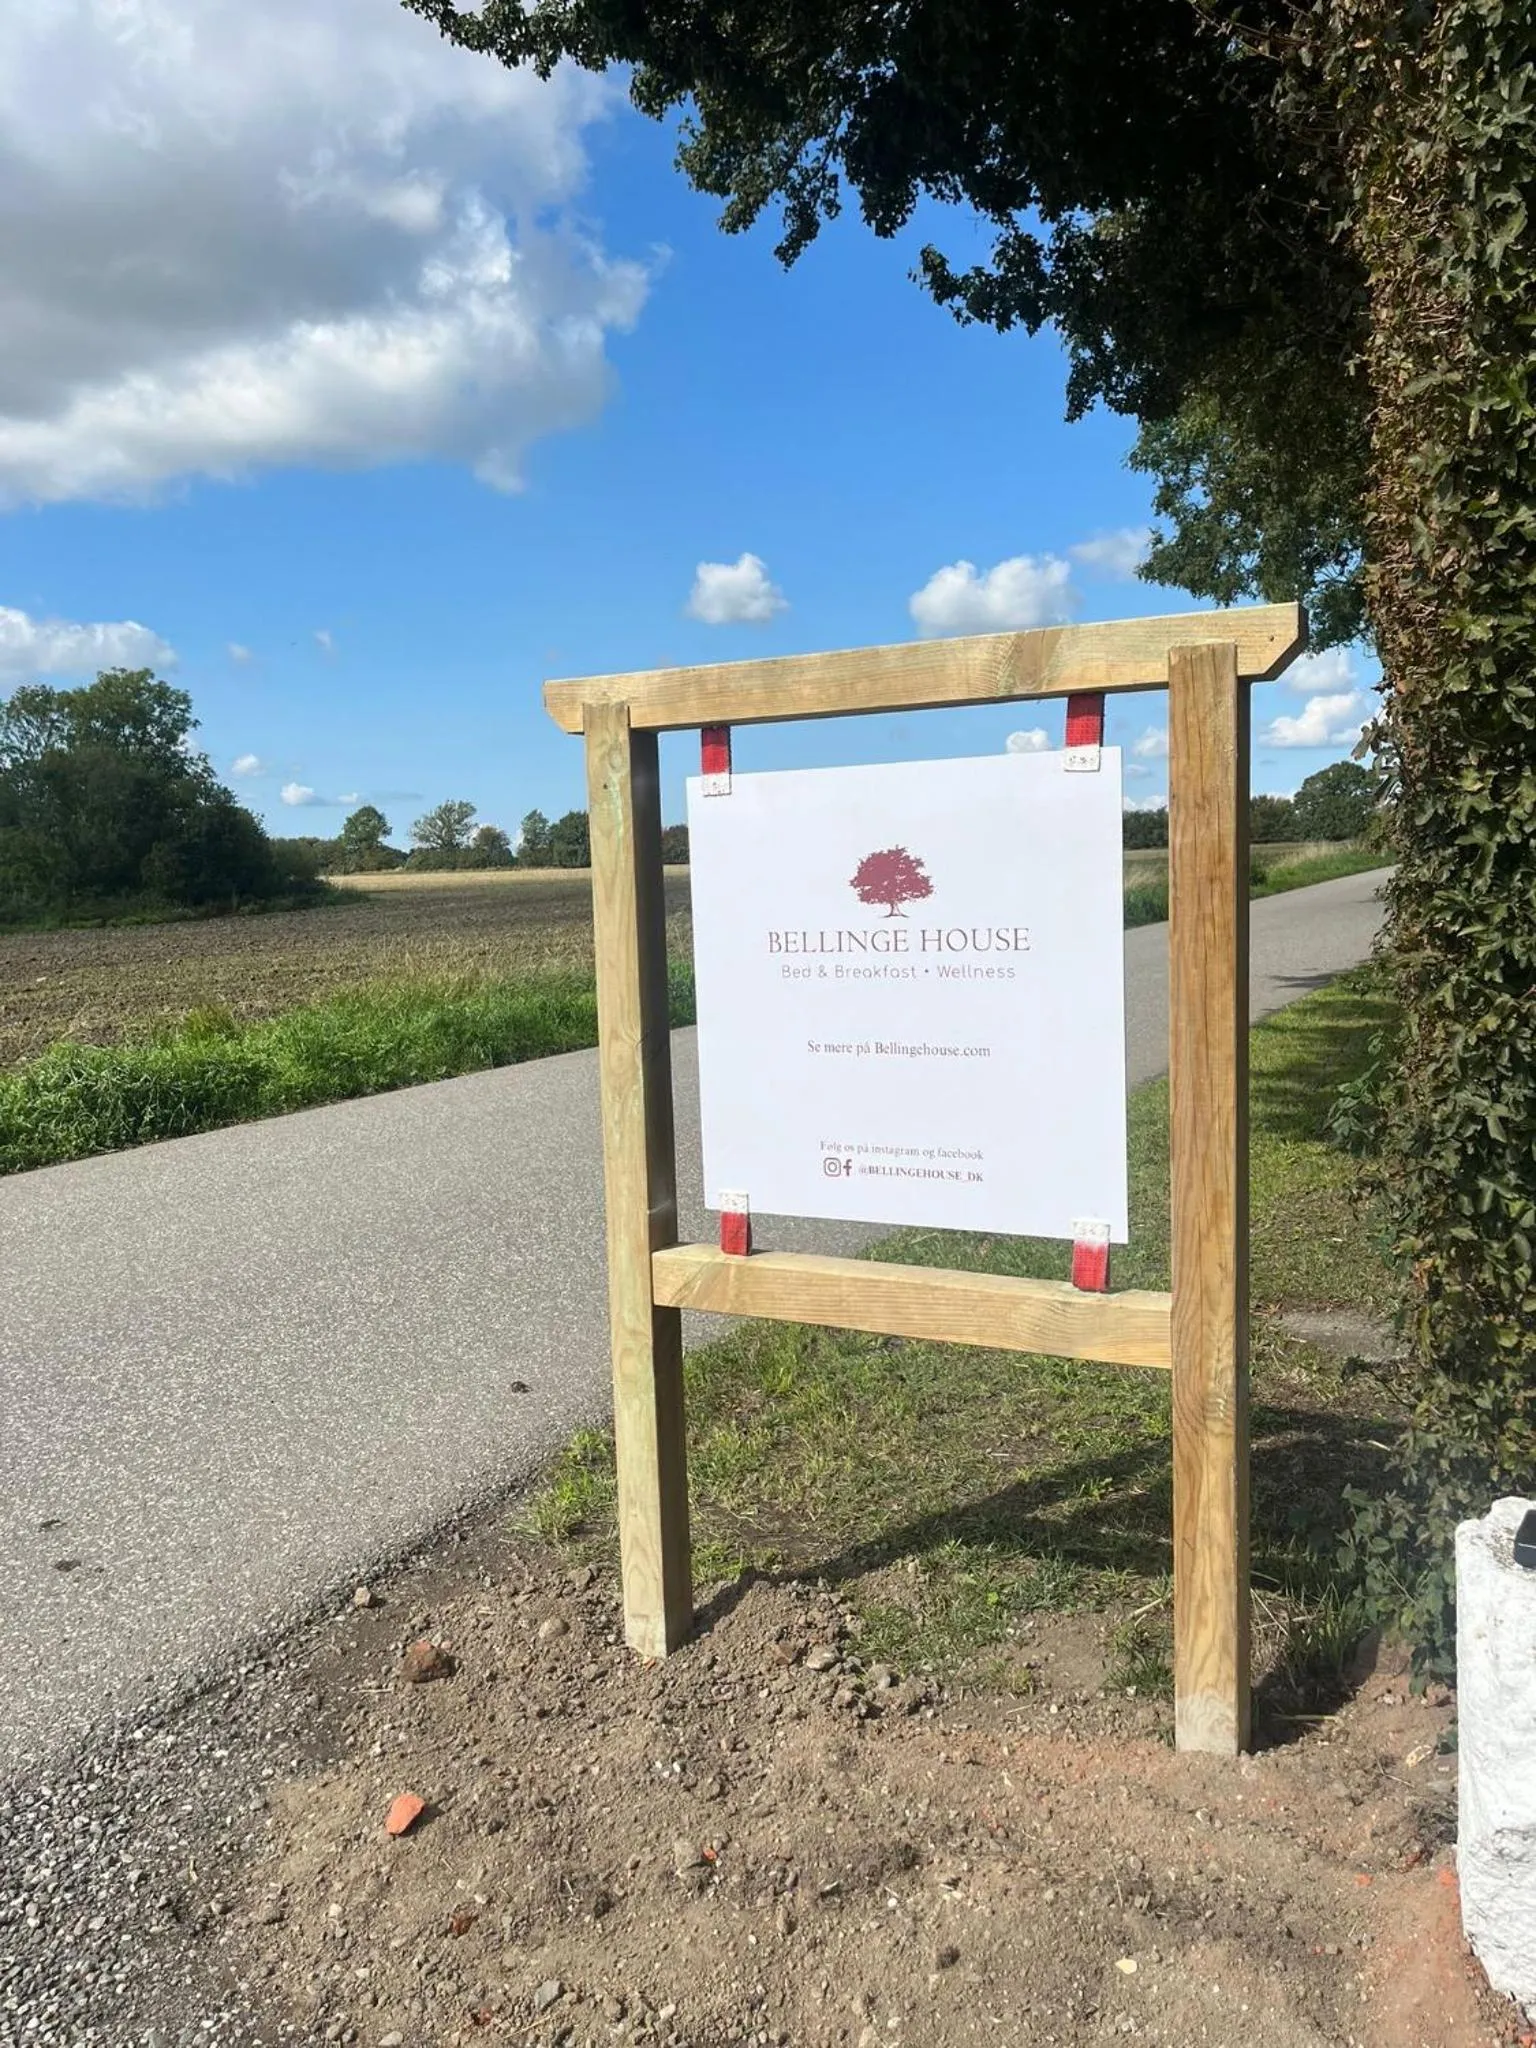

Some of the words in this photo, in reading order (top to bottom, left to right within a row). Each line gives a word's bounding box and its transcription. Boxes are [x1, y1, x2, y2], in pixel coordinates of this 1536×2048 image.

[769, 929, 909, 953] BELLINGE
[920, 927, 1031, 952] HOUSE
[781, 965, 811, 978] Bed
[818, 965, 828, 978] &
[835, 965, 917, 978] Breakfast
[937, 965, 1016, 978] Wellness
[807, 1040, 821, 1053] Se
[824, 1043, 853, 1054] mere
[856, 1041, 871, 1057] på
[875, 1042, 992, 1058] Bellingehouse.com
[844, 1143, 855, 1151] os
[857, 1143, 869, 1155] på
[871, 1144, 920, 1158] instagram
[922, 1148, 935, 1159] og
[937, 1147, 984, 1160] facebook
